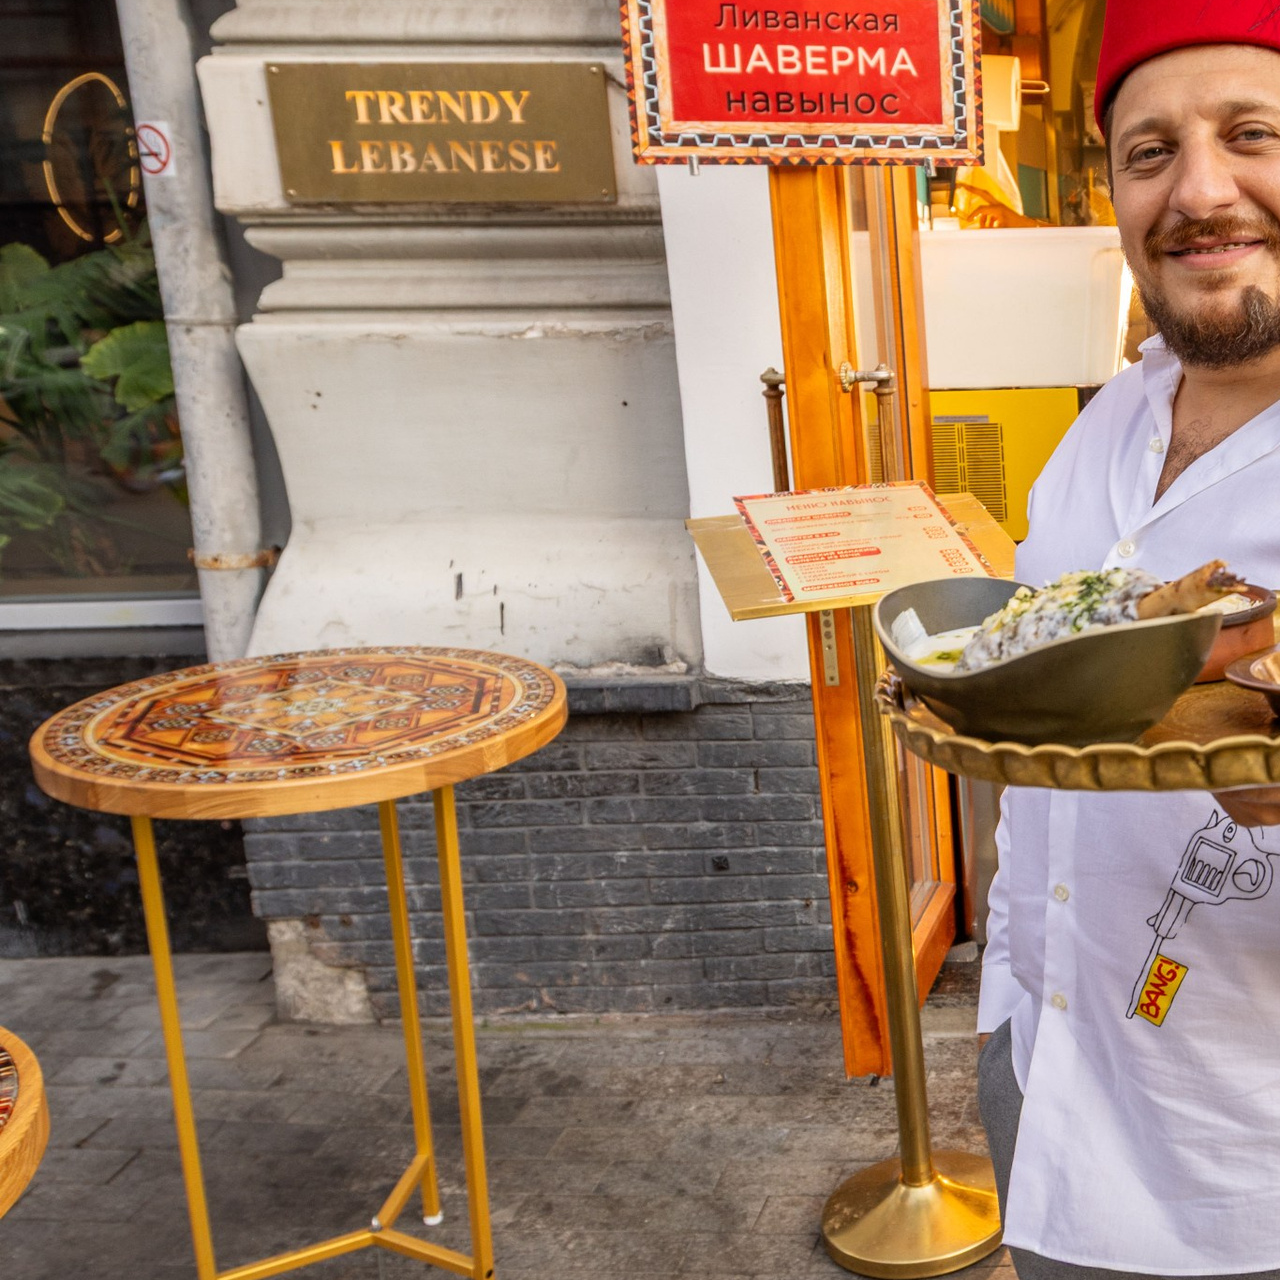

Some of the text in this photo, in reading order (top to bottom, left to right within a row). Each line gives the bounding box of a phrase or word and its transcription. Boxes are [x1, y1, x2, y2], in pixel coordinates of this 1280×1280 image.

[714, 2, 899, 32] Ливанская
[702, 43, 918, 77] ШАВЕРМА
[345, 90, 531, 124] TRENDY
[726, 90, 900, 116] навынос
[328, 139, 562, 174] LEBANESE
[786, 496, 892, 511] МЕНЮ НАВЫНОС
[1140, 958, 1182, 1019] BANG!
